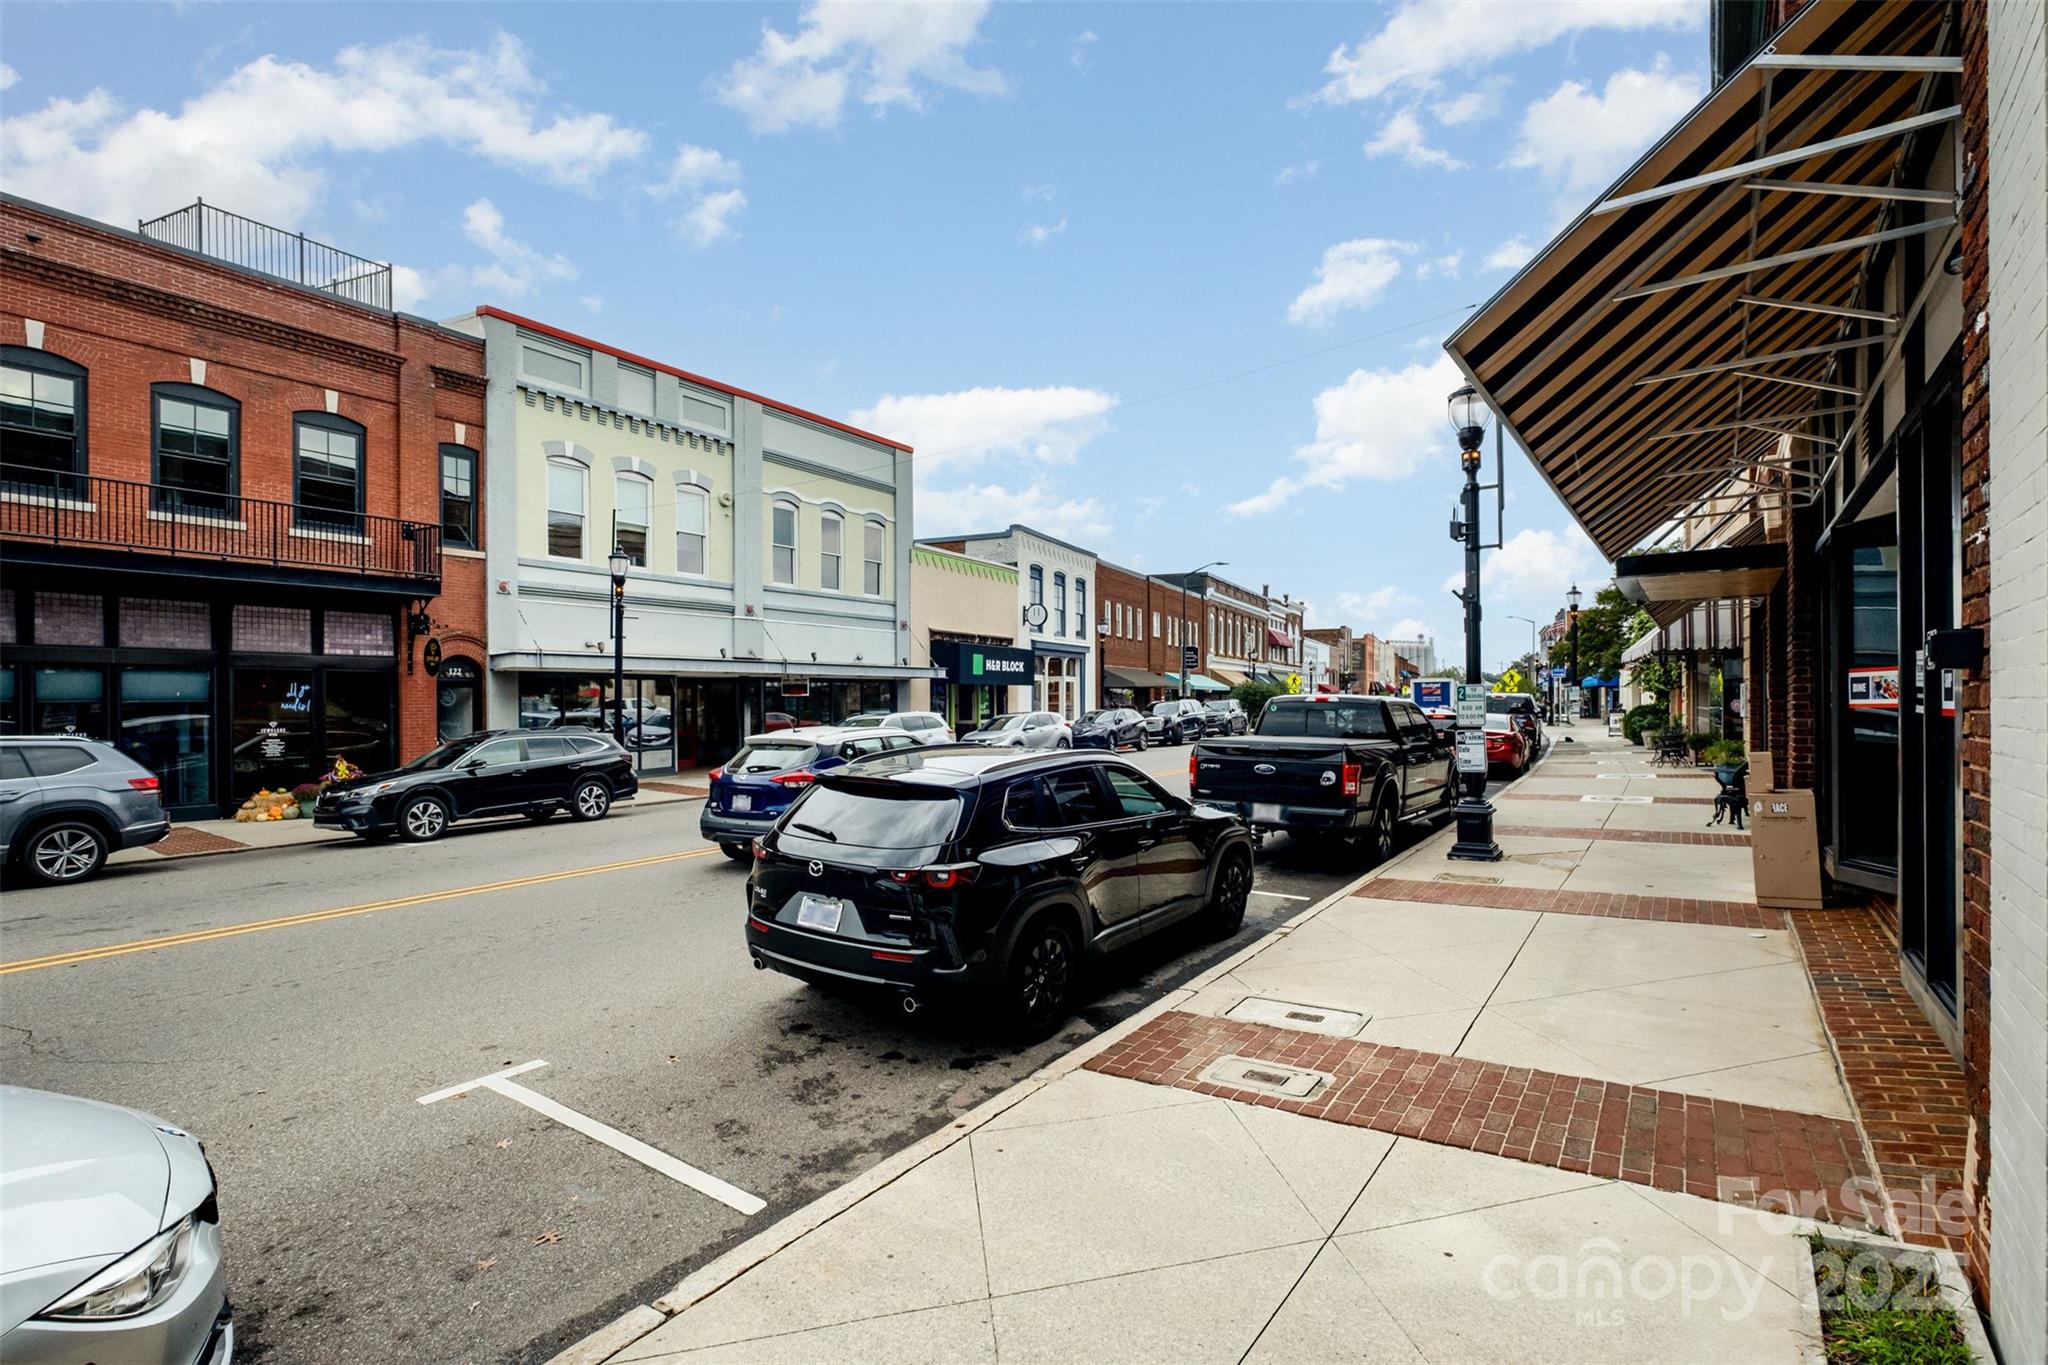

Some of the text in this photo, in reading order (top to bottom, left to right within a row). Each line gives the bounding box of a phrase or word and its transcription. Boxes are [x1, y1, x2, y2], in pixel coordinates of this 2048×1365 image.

[986, 659, 1024, 672] H&R BLOCK
[448, 668, 462, 676] 122
[1458, 687, 1465, 699] 2
